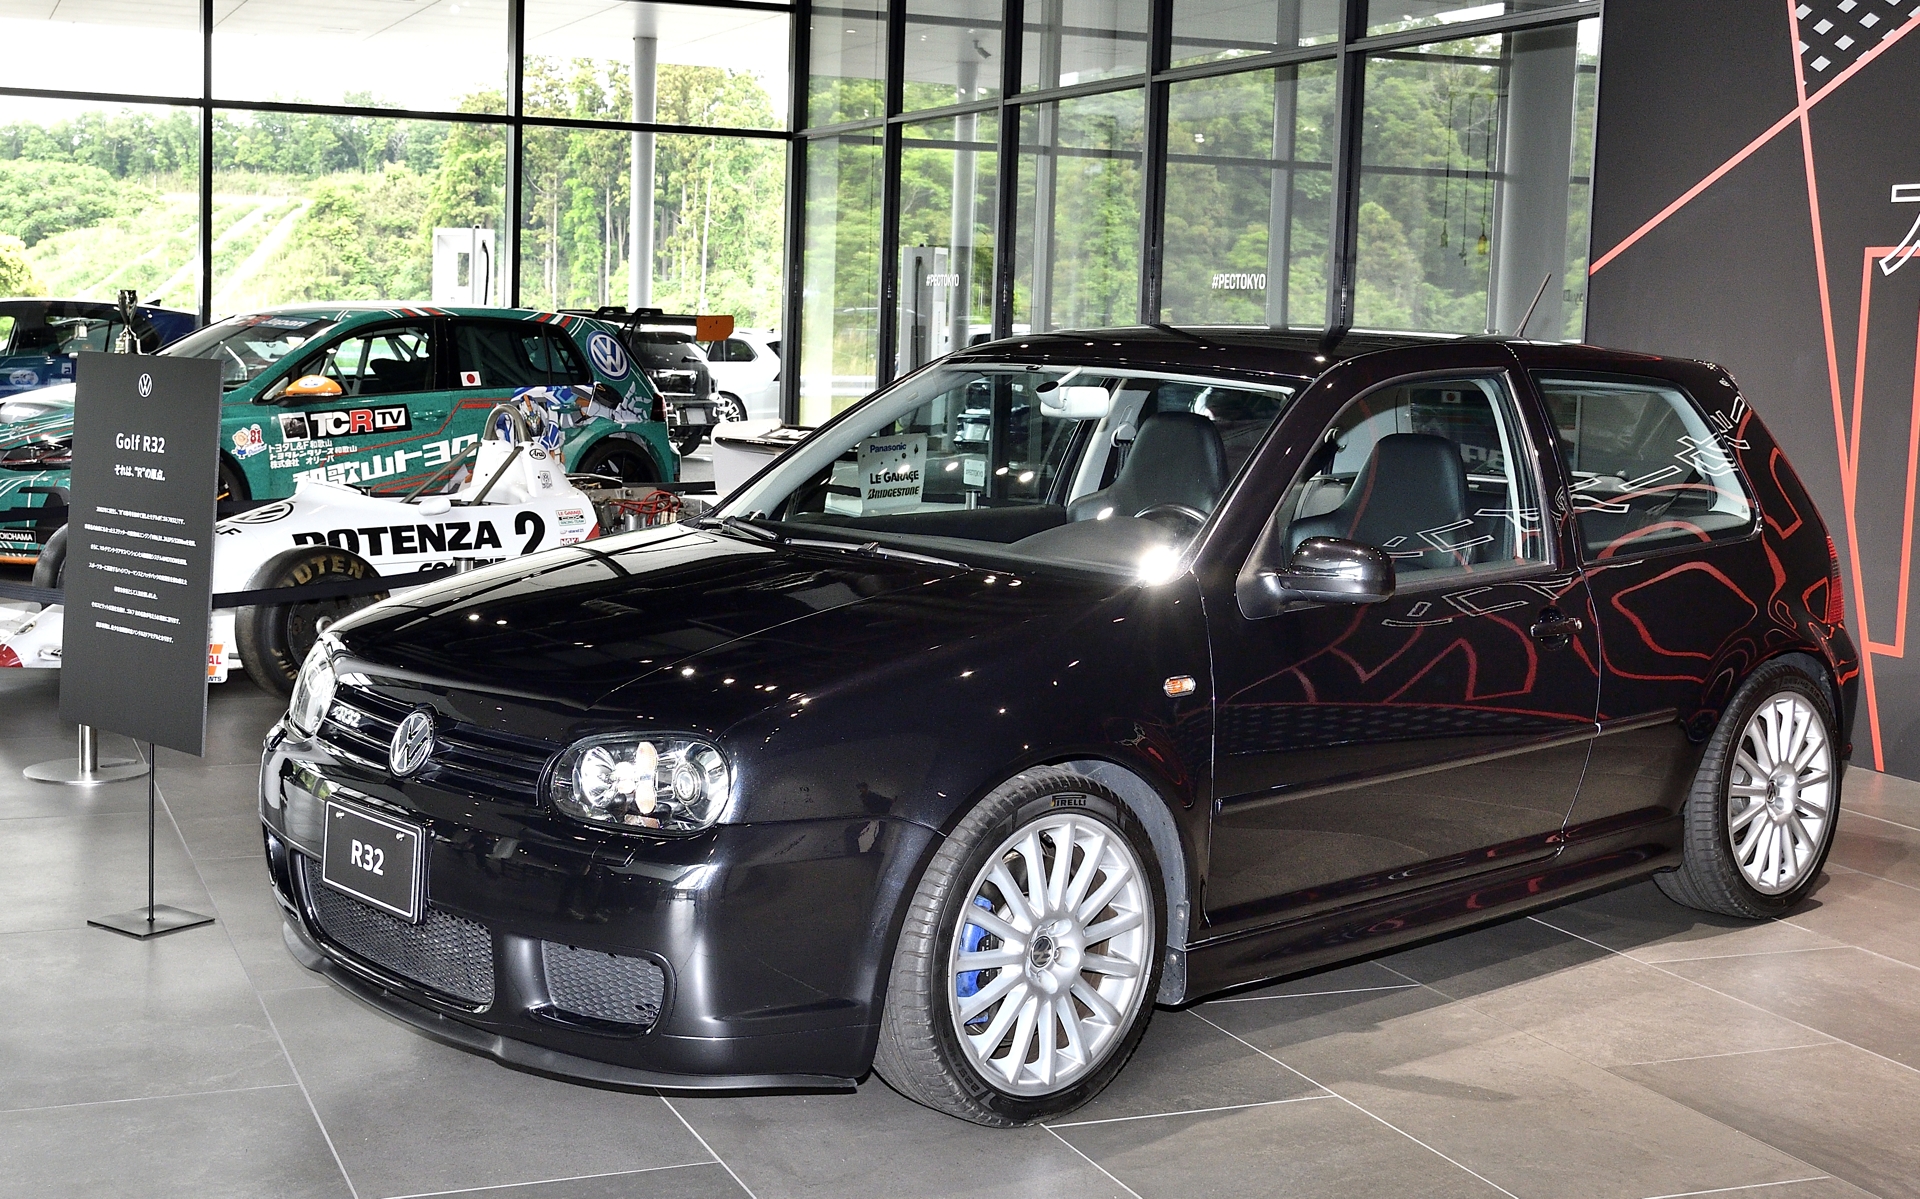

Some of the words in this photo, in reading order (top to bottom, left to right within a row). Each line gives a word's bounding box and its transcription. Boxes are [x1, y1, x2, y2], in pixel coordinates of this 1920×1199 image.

[926, 273, 960, 287] #PECTOKYO
[1211, 273, 1266, 290] #PECTOKYO
[311, 409, 373, 437] TCR
[376, 410, 404, 425] TV
[115, 432, 140, 451] Golf
[143, 435, 165, 454] R32
[250, 429, 263, 444] 81
[869, 442, 907, 453] Panasonic
[869, 473, 882, 484] LE
[867, 486, 920, 500] BRIDGESTONE
[0, 532, 33, 541] OKOHAMA
[1051, 794, 1087, 807] PIRELLI
[350, 838, 385, 876] R32
